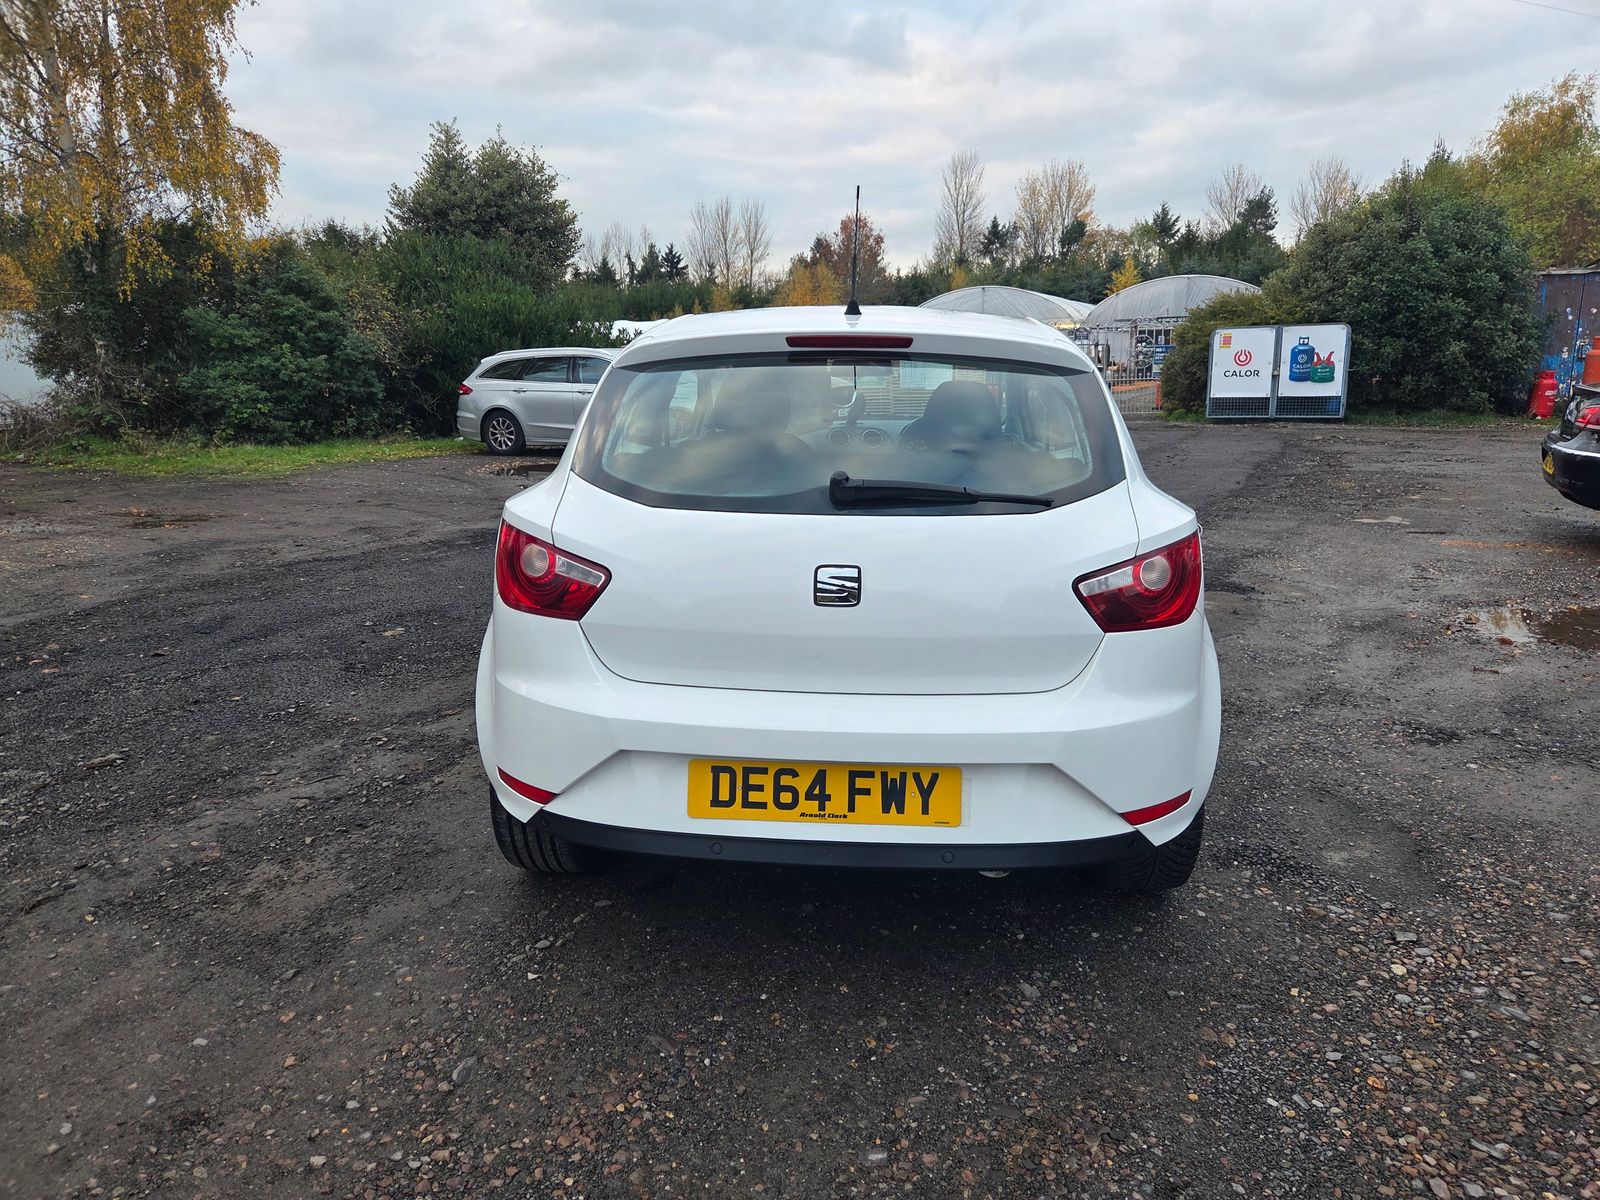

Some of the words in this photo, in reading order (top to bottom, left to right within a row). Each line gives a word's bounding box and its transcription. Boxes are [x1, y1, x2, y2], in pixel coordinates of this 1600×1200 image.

[1223, 369, 1260, 378] CALOR
[709, 765, 832, 812] DE64
[847, 769, 940, 816] FWY
